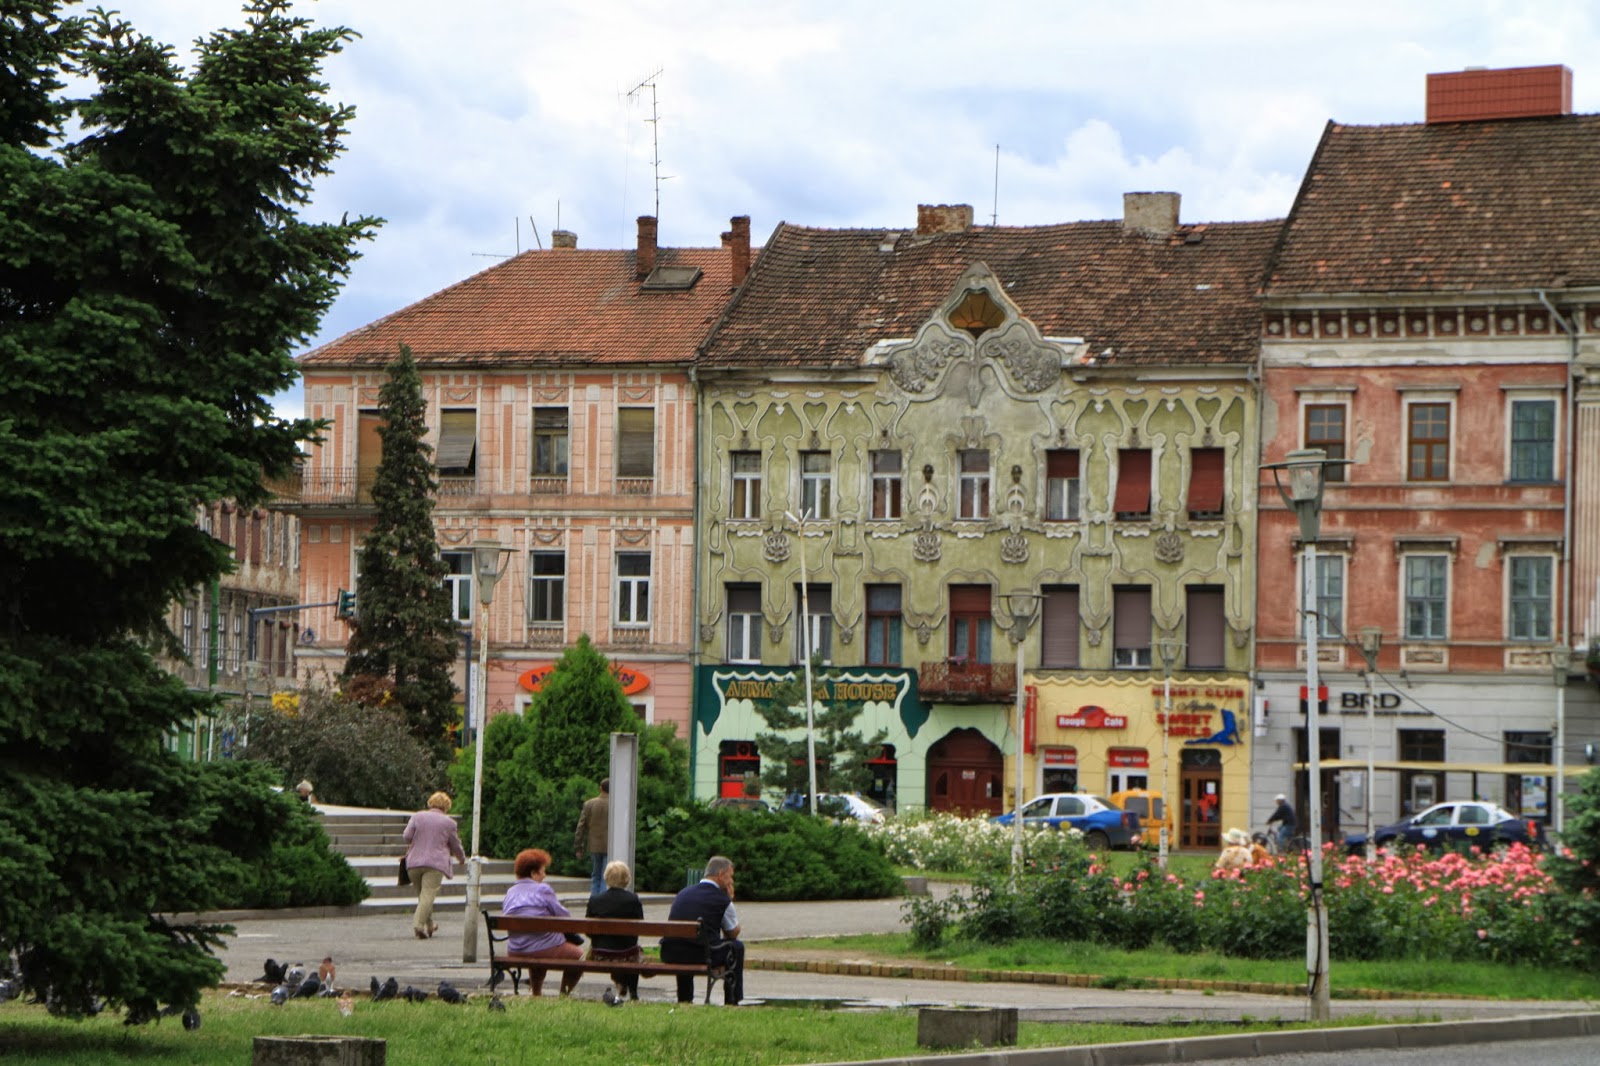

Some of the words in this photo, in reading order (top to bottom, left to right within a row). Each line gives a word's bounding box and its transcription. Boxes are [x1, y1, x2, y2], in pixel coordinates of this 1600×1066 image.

[725, 681, 783, 699] AHMA
[833, 683, 897, 700] HOUSE
[1205, 688, 1244, 698] CLUB
[1341, 692, 1401, 709] BRD
[1058, 717, 1086, 727] Rouge
[1104, 717, 1124, 727] Café
[1156, 713, 1212, 725] SWEET
[1166, 727, 1212, 738] GIRLS
